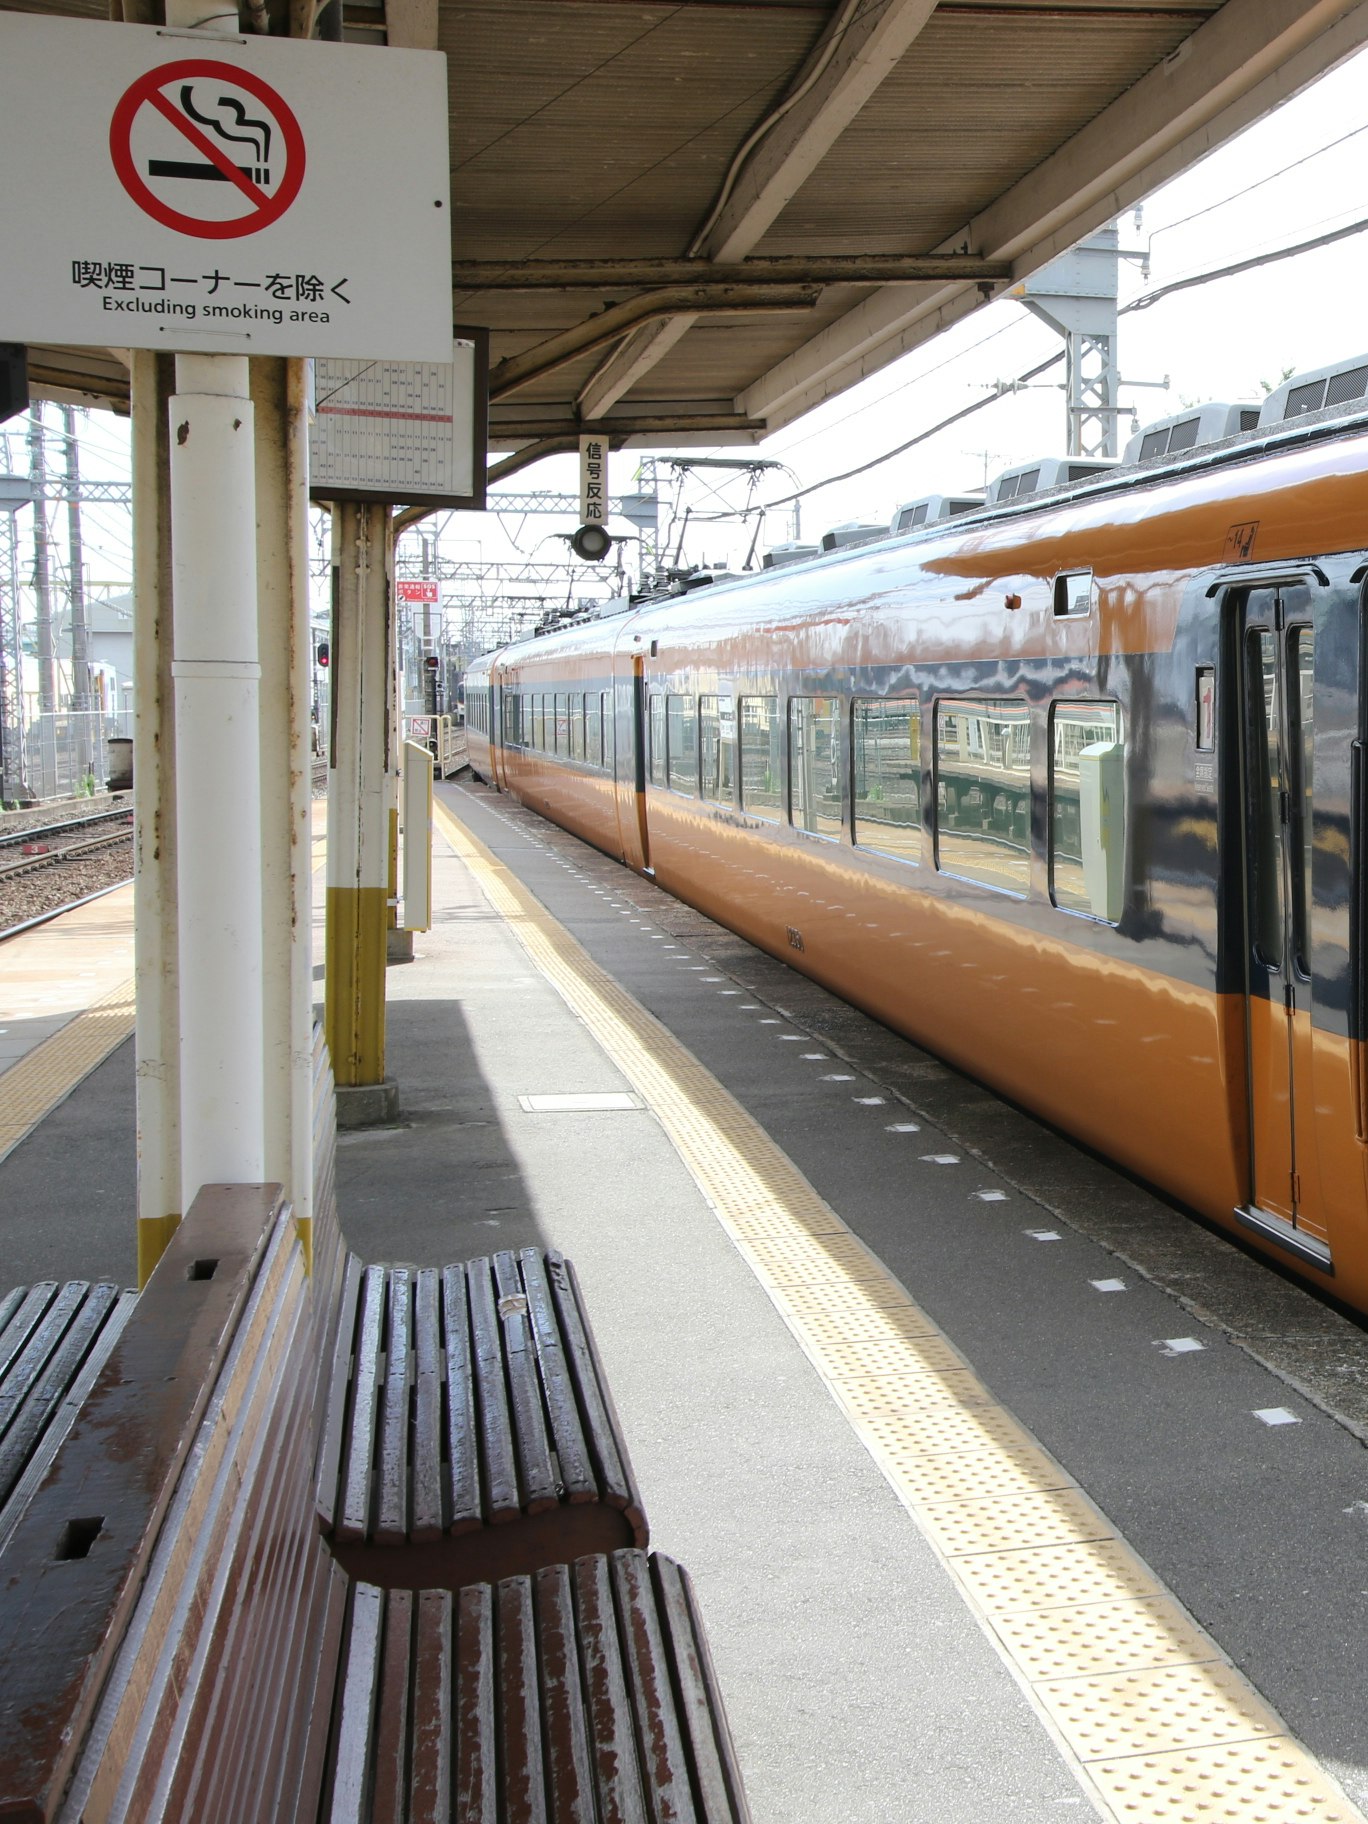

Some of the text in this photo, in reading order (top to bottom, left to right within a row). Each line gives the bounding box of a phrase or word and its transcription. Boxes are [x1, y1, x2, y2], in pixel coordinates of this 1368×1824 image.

[72, 260, 351, 304] 喫煙コーナーを除く
[103, 296, 330, 324] Excluding smoking area
[586, 442, 602, 519] 信号反応
